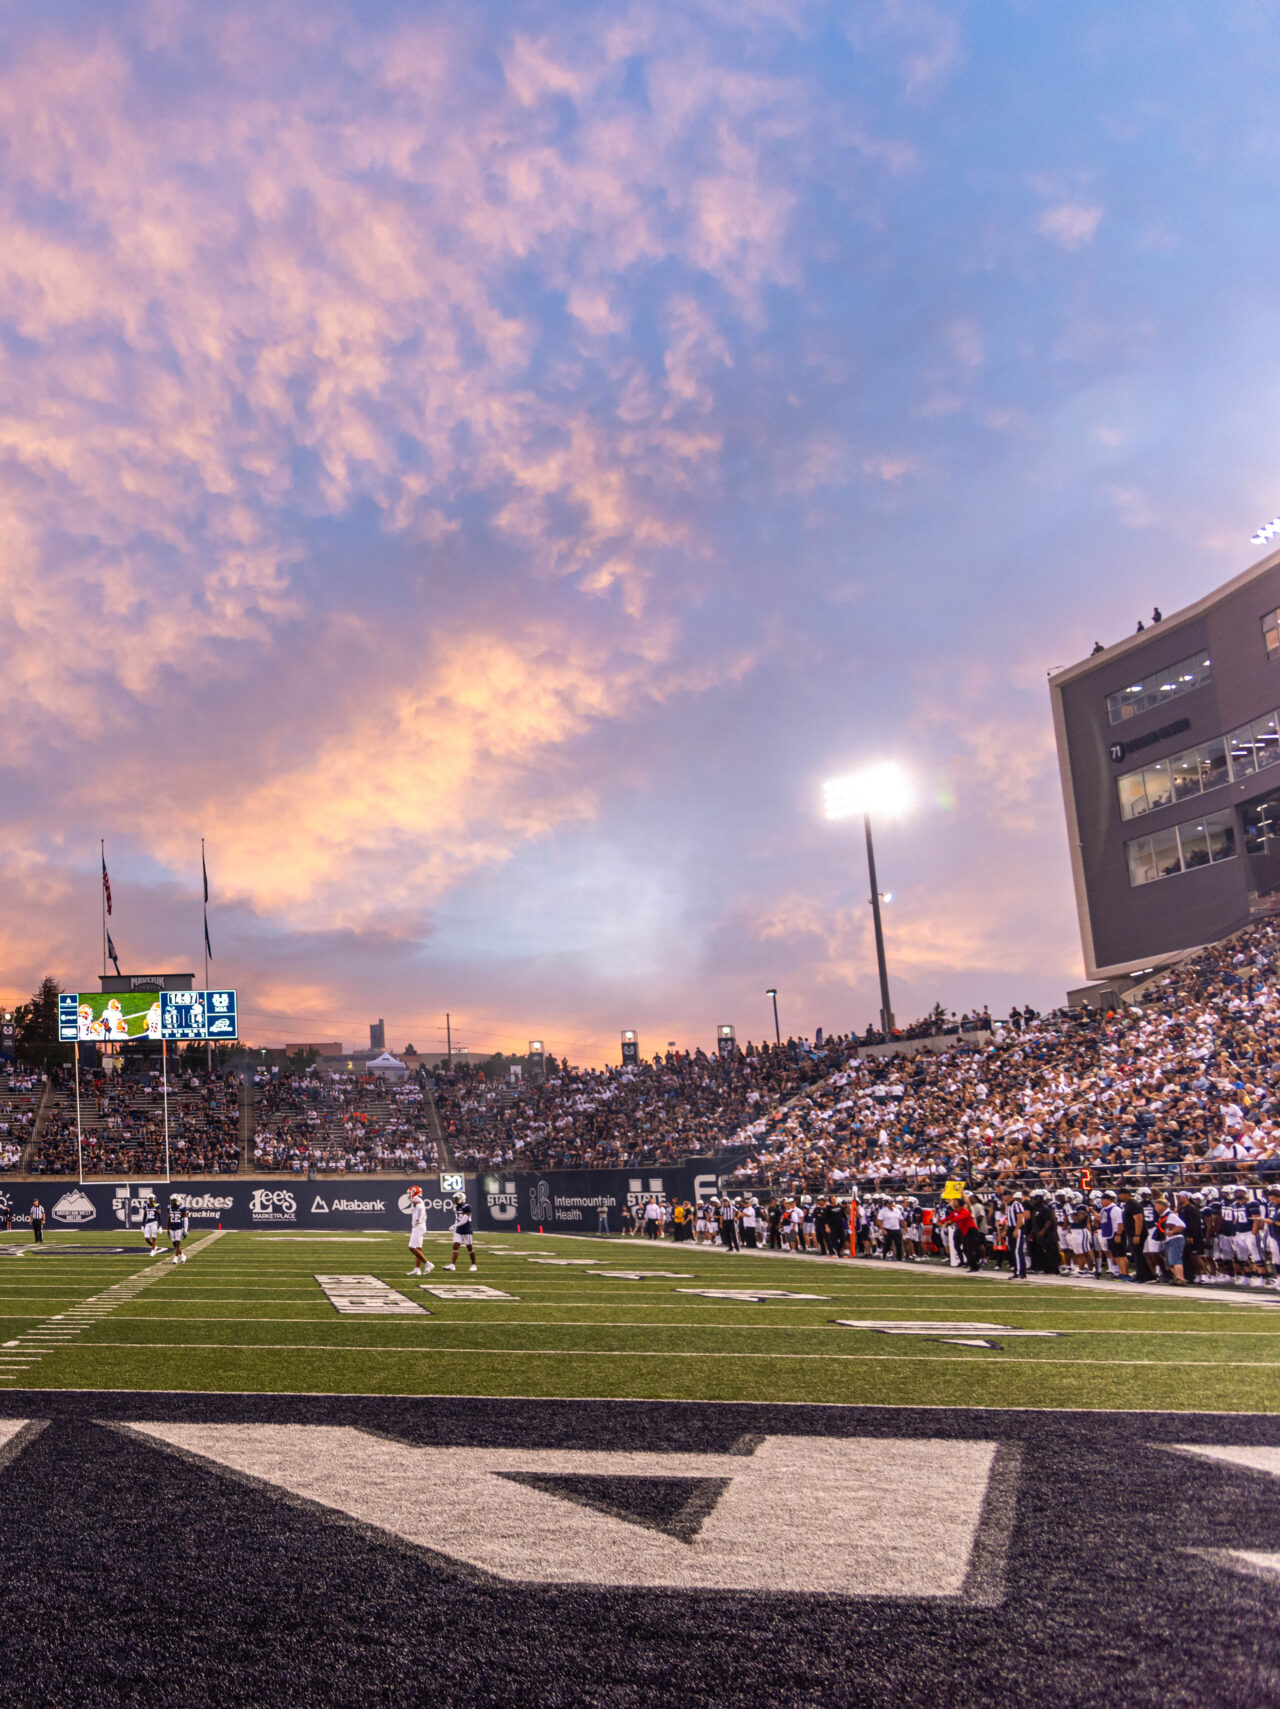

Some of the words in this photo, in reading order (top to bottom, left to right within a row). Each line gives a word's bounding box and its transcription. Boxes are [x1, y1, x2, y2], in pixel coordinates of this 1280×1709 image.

[1110, 745, 1121, 759] 71
[130, 976, 165, 989] MAVERIK
[443, 1175, 463, 1190] 20
[1080, 1169, 1092, 1190] 2
[249, 1188, 297, 1213] Lee's
[332, 1199, 385, 1211] Altabank
[487, 1194, 518, 1207] STATE
[554, 1195, 616, 1207] Intermountain
[555, 1208, 582, 1220] Health
